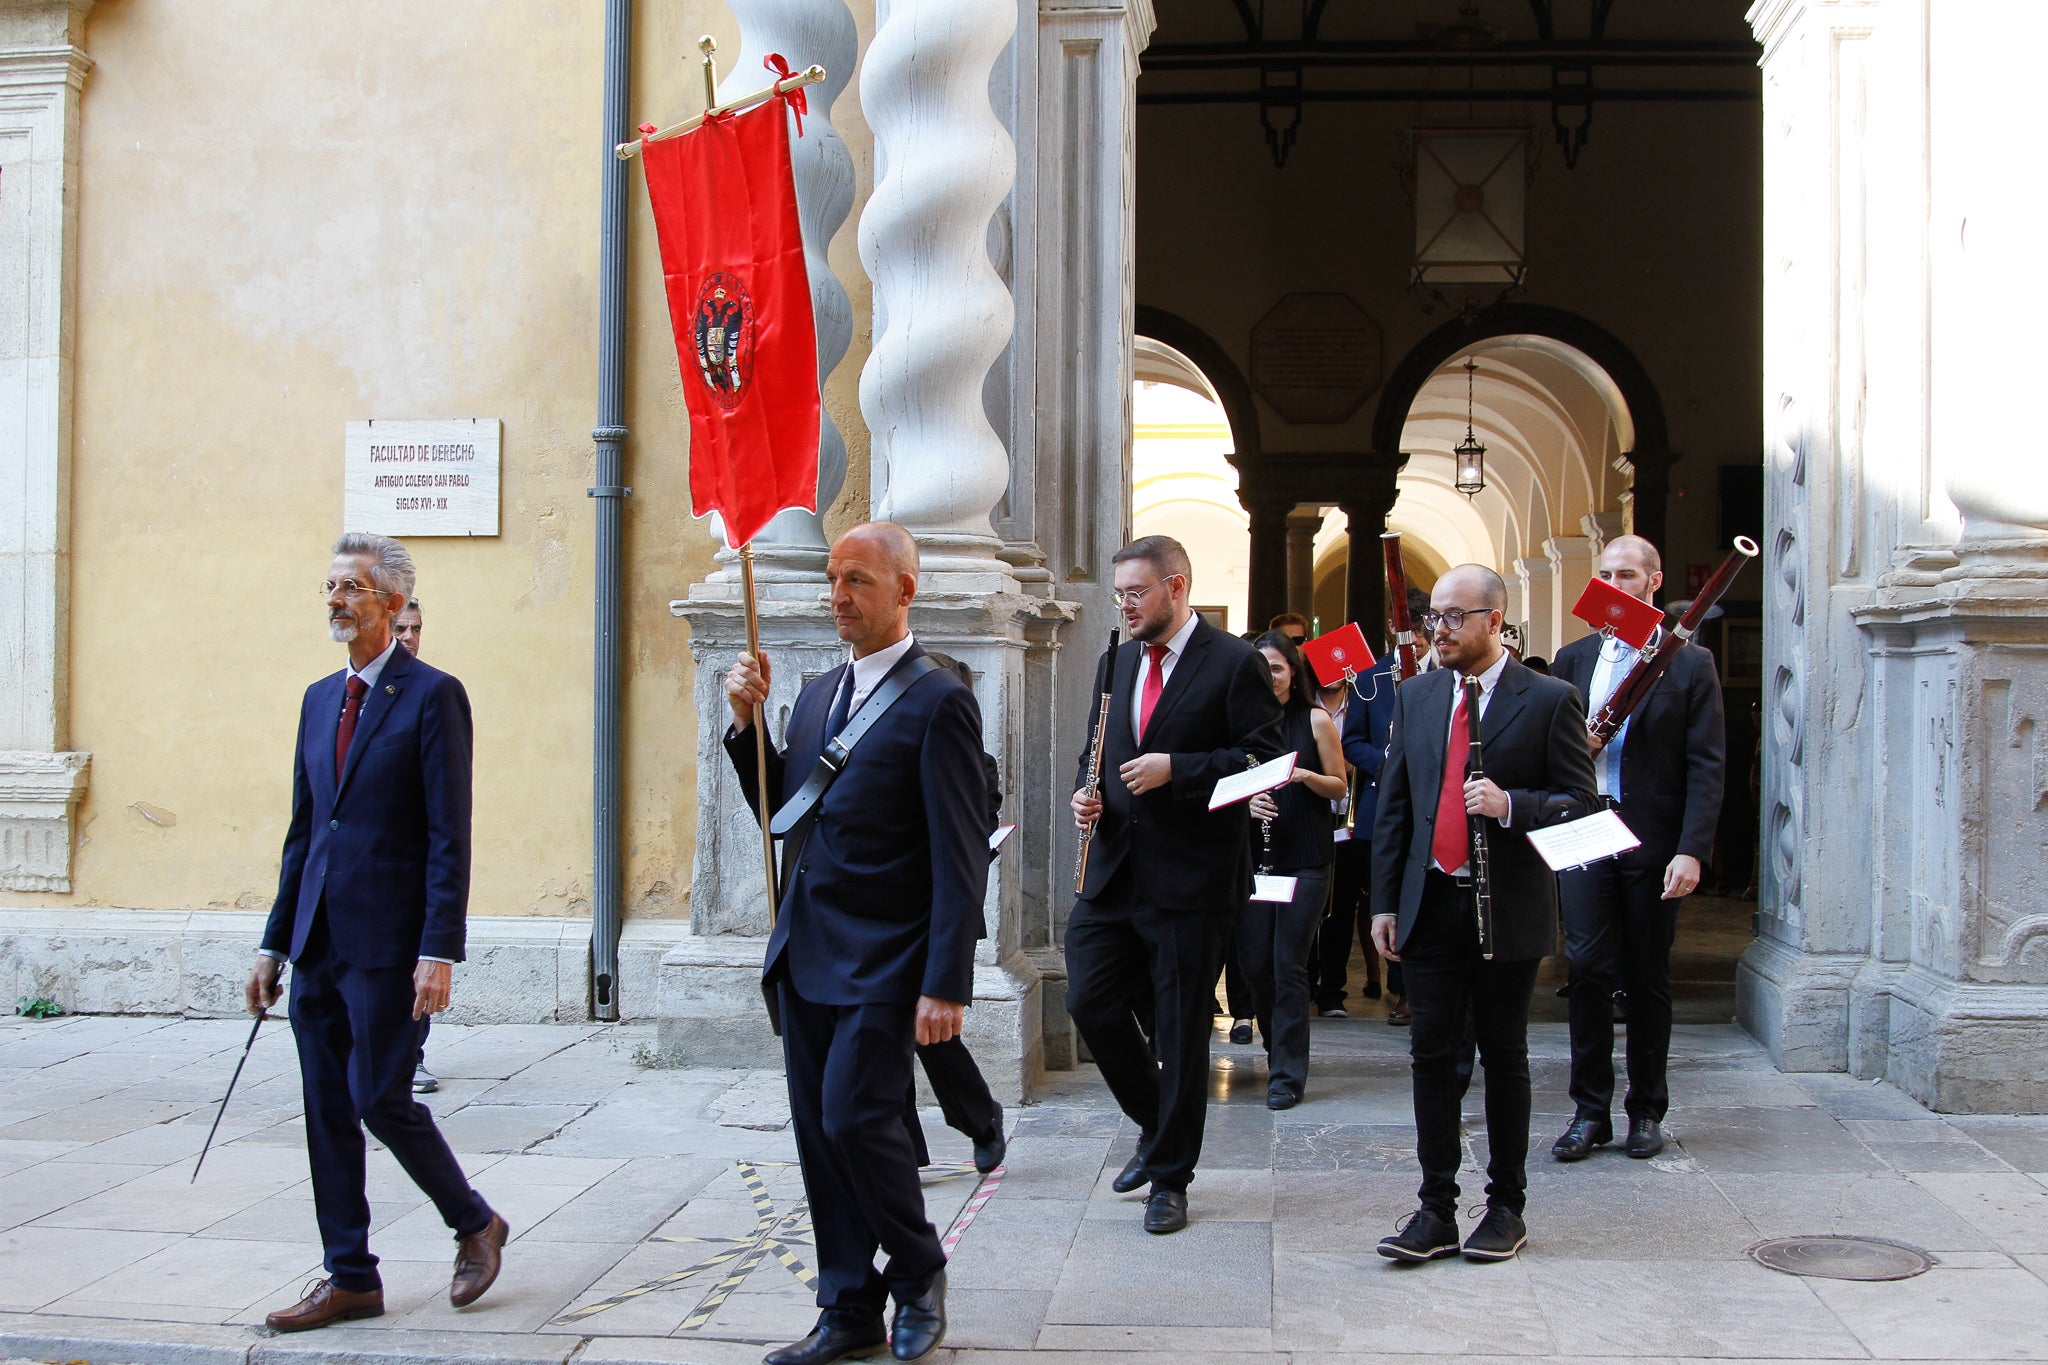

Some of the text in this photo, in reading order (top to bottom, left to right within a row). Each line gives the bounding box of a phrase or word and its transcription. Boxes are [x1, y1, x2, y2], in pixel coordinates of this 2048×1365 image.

[370, 444, 475, 463] FACULTAD DE DERECHO
[375, 474, 470, 488] ANTIGUO COLEGIO SAN PABLO
[396, 497, 419, 510] SIGLOS
[421, 497, 431, 510] XVI
[437, 497, 448, 510] XIX
